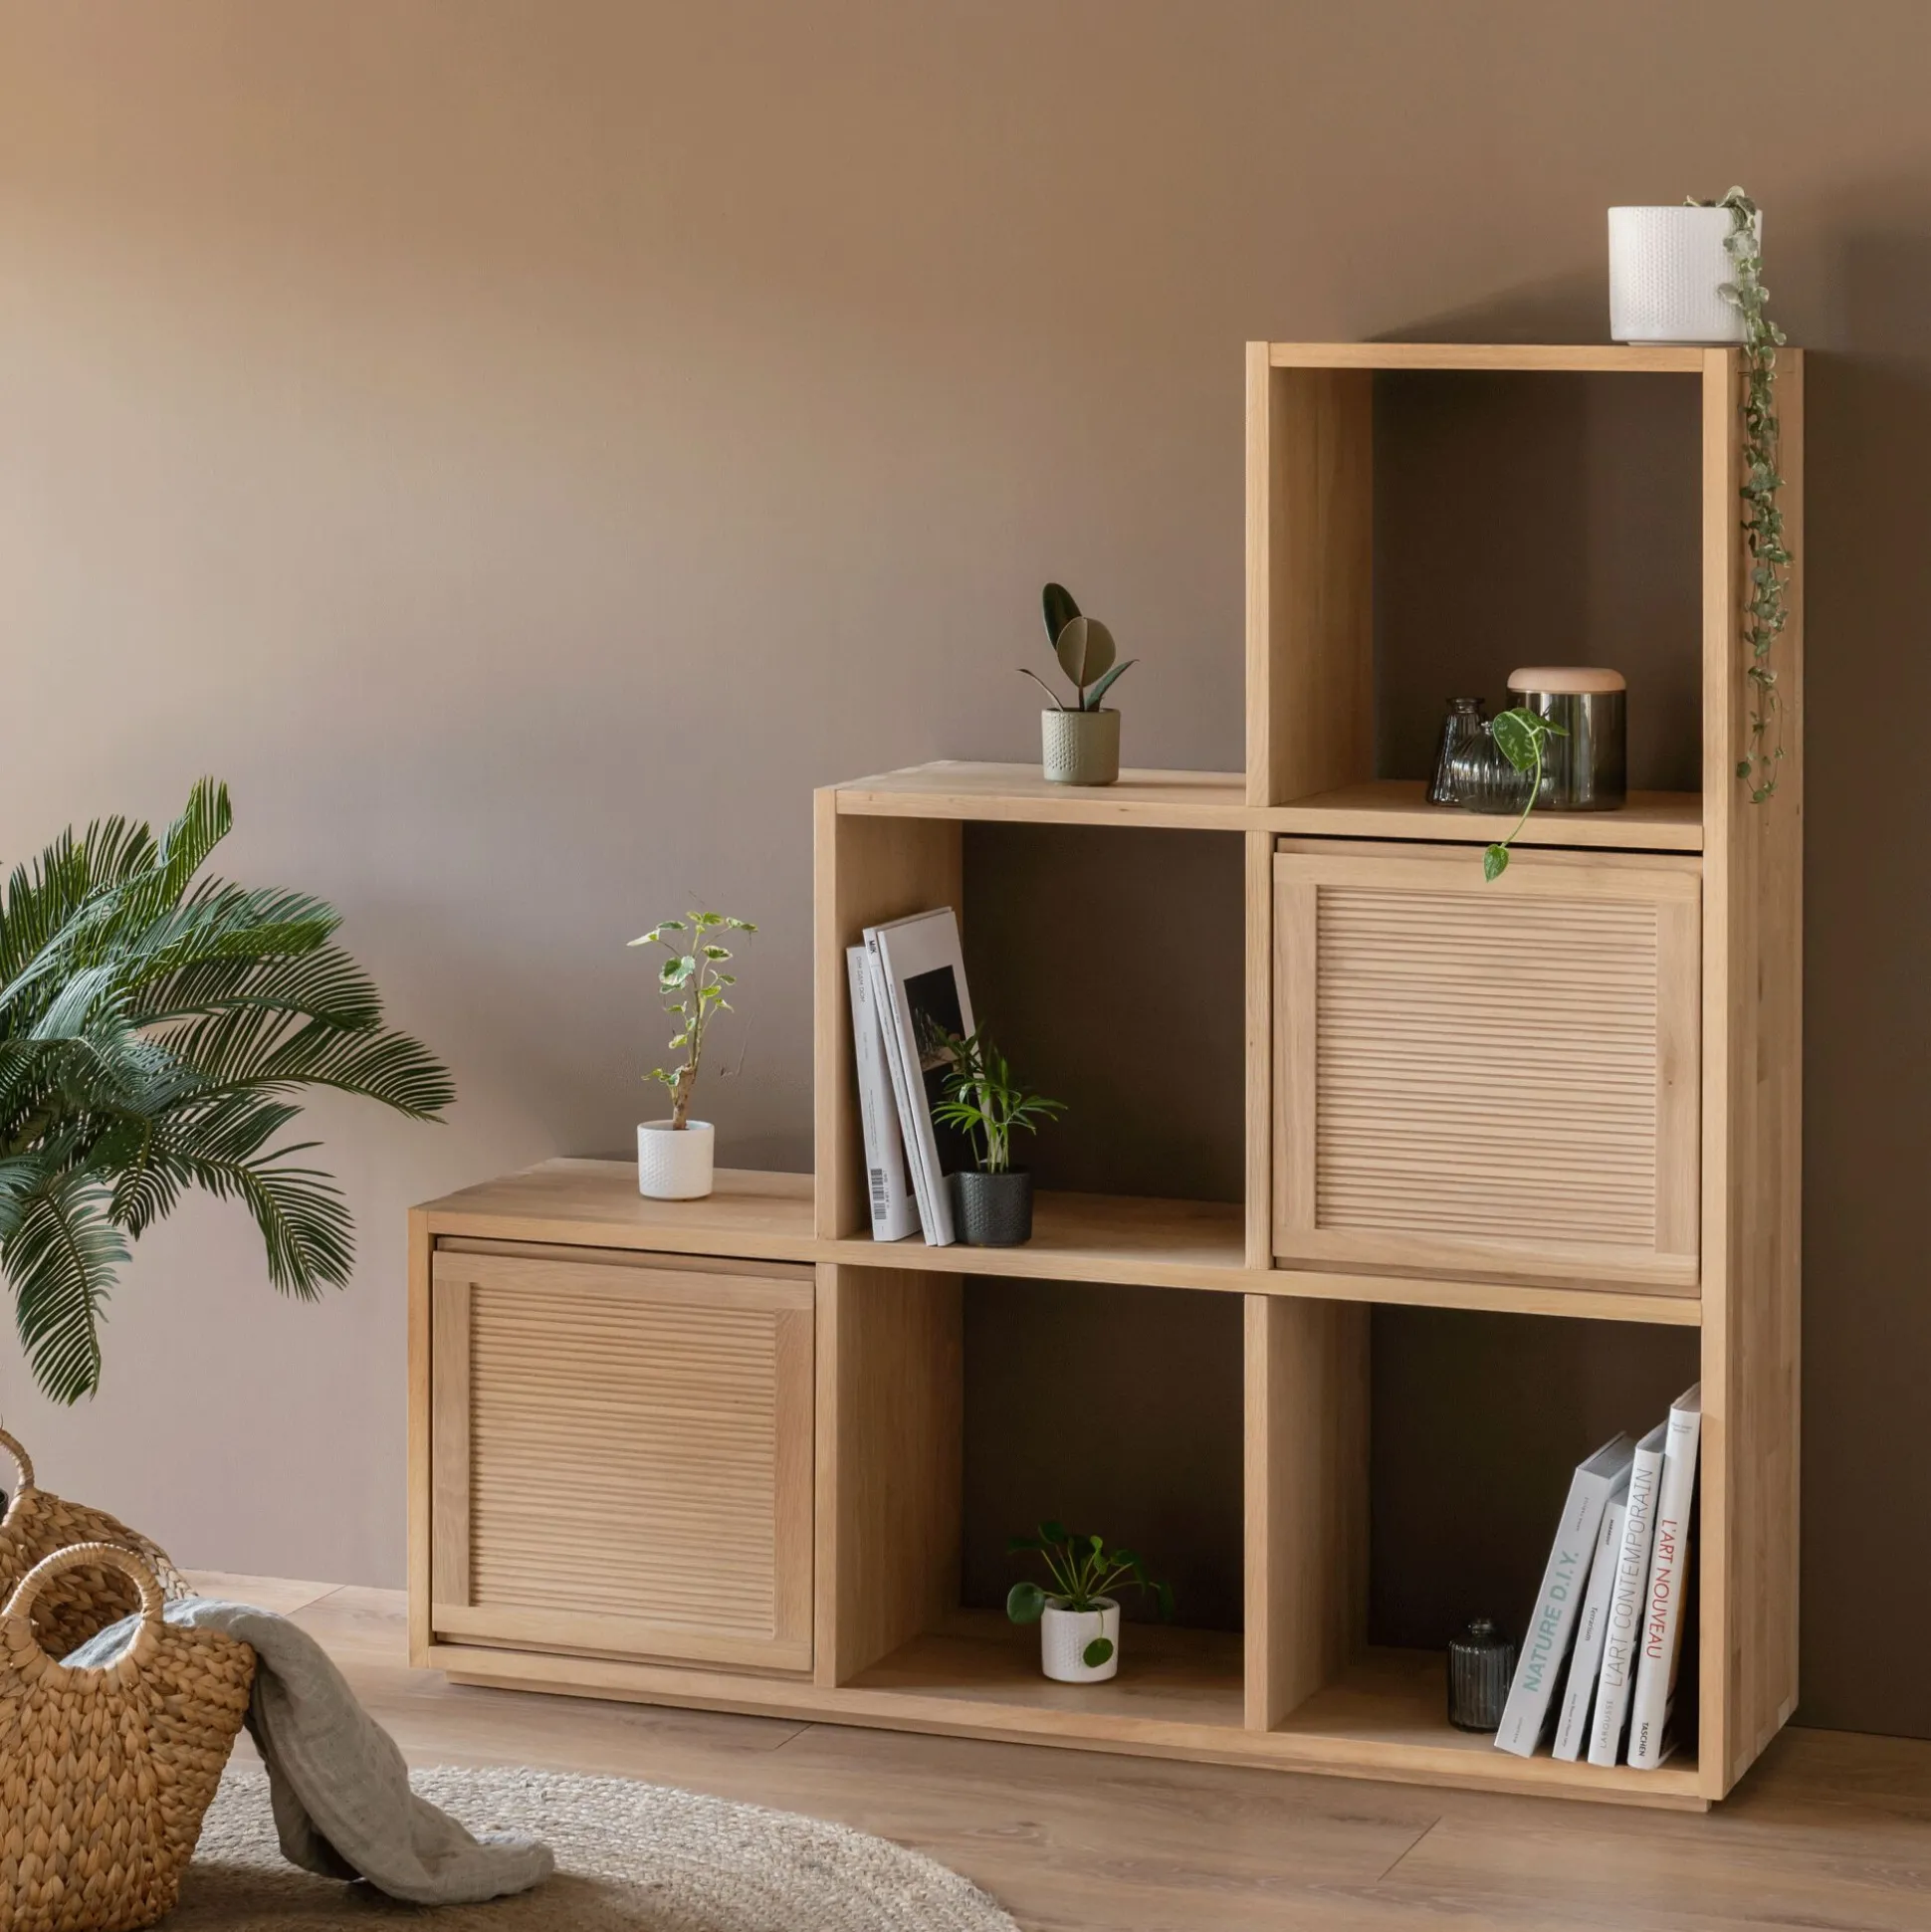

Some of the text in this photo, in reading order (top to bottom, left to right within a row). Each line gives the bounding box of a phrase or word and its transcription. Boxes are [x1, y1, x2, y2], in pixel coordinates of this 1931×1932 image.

[1522, 1551, 1579, 1692] NATURE D.I.Y.
[1585, 1608, 1599, 1641] Terrarium
[1605, 1468, 1653, 1687] L'ART CONTEMPORAIN
[1646, 1519, 1678, 1659] L'ART NOUVEAU
[1600, 1700, 1613, 1749] LAROUSSE
[1638, 1722, 1649, 1757] TASCHEN
